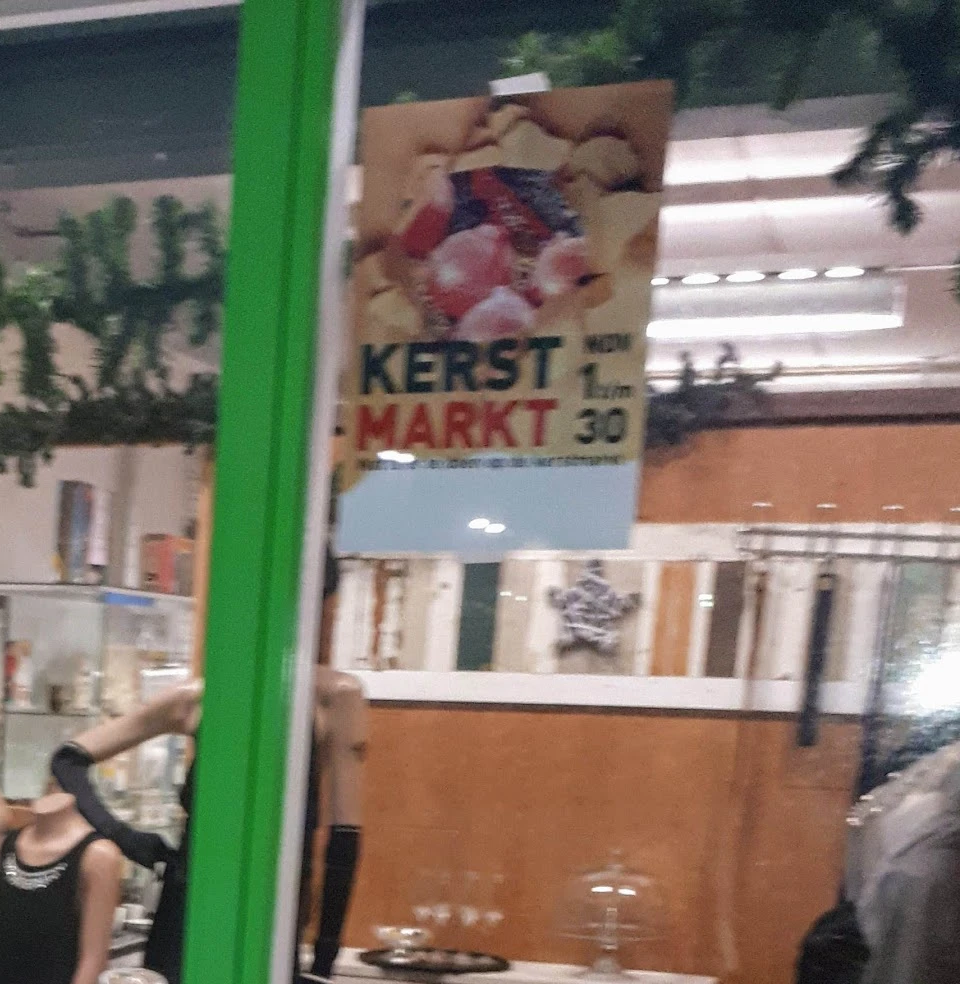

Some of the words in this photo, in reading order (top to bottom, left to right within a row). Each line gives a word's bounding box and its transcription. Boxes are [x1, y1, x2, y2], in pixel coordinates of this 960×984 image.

[360, 336, 563, 395] KERST
[357, 398, 560, 450] MARKT
[575, 407, 628, 444] 30
